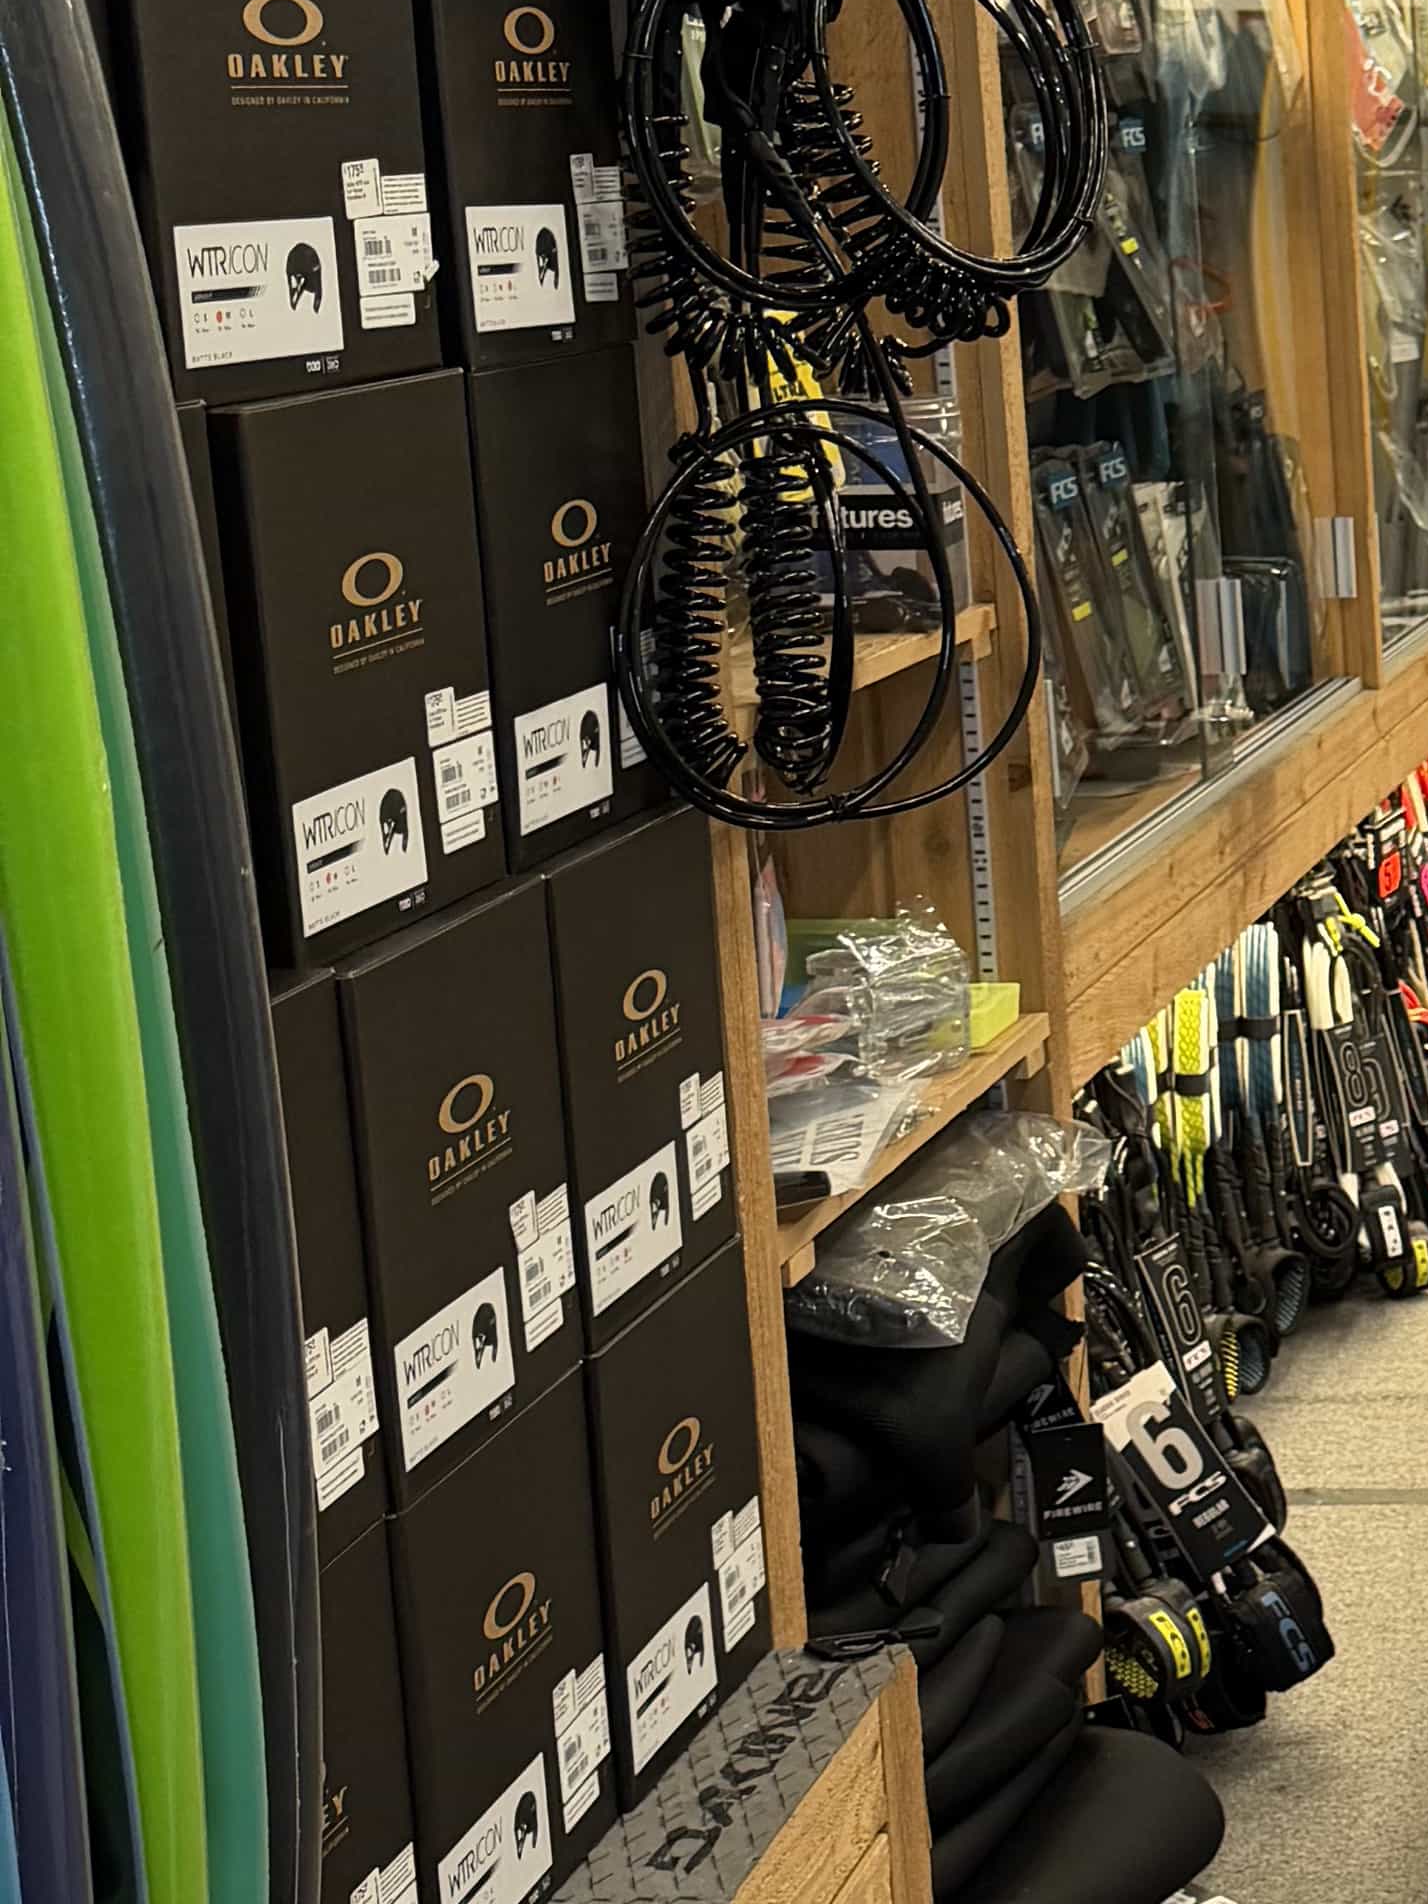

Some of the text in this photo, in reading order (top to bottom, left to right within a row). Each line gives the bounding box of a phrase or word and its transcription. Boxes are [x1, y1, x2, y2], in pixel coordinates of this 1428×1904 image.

[227, 54, 349, 79] OAKLEY
[495, 60, 570, 83] OAKLEY
[1122, 127, 1146, 147] FCS
[1050, 476, 1079, 505] FCS
[1100, 456, 1127, 483] FCS
[810, 505, 914, 529] ftures
[543, 542, 612, 584] OAKLEY
[330, 599, 423, 650] OAKLEY
[615, 1003, 681, 1062] OAKLEY
[427, 1109, 511, 1183] OAKLEY
[1161, 1264, 1203, 1346] 6
[1126, 1400, 1204, 1490] 6
[651, 1443, 715, 1520] OAKLEY
[1168, 1470, 1228, 1517] FCS
[1043, 1500, 1103, 1521] FIREWIRE
[473, 1598, 553, 1692] OAKLEY
[1262, 1591, 1317, 1673] FCS
[647, 1664, 848, 1875] DAKINE
